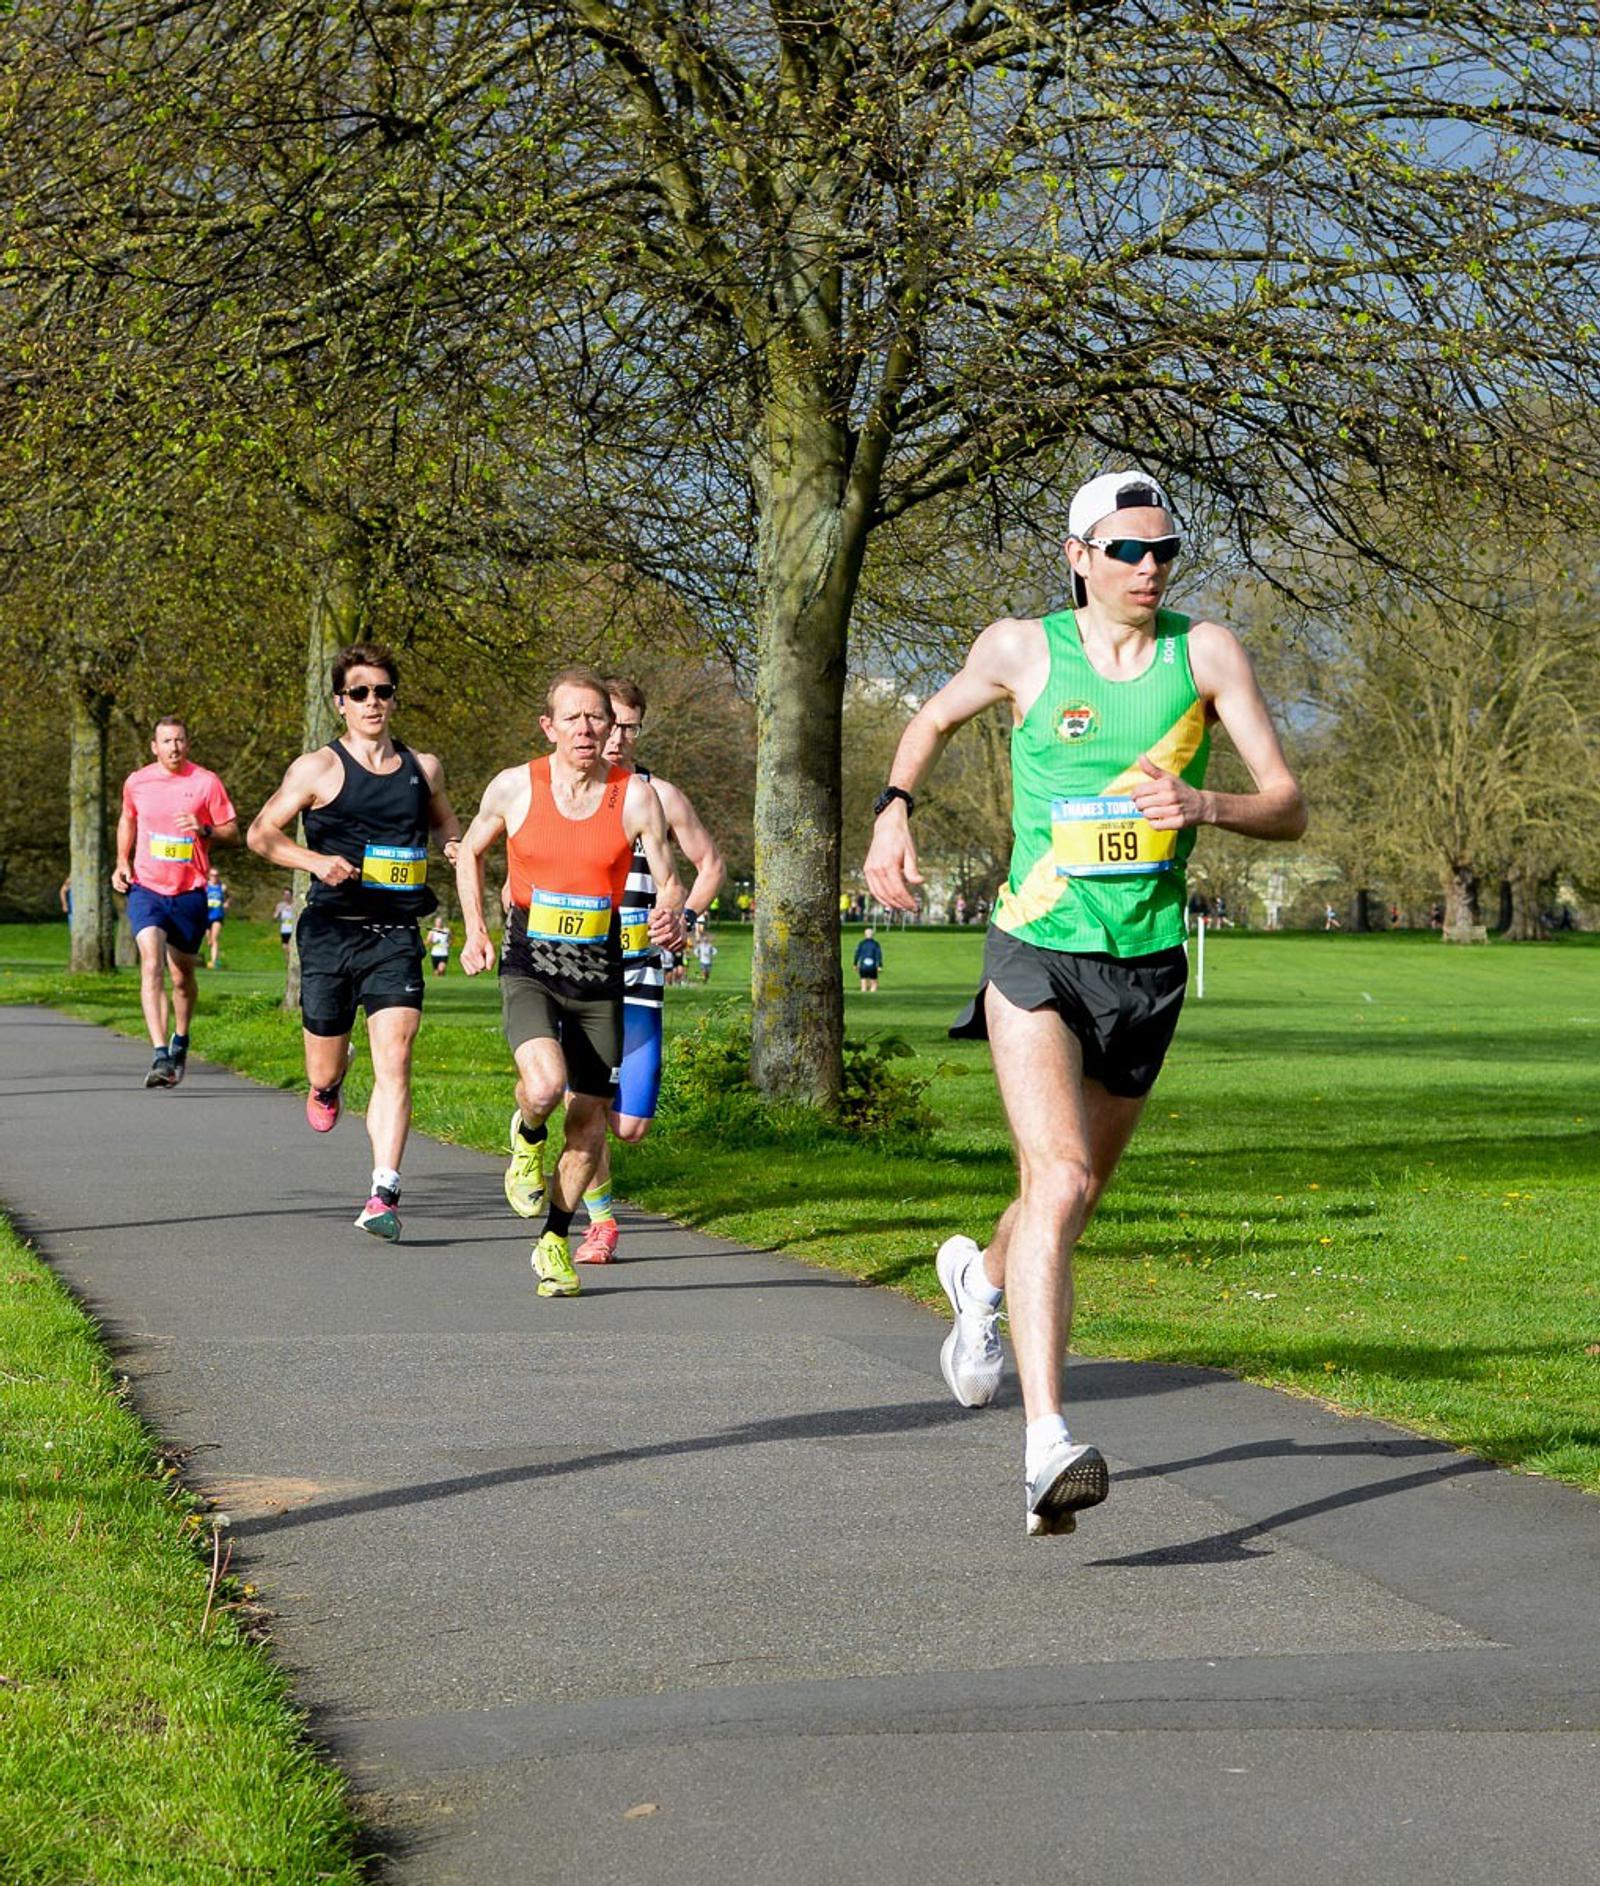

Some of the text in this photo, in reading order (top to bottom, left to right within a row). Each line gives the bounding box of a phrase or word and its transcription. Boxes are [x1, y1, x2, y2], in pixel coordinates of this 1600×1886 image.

[1062, 800, 1139, 817] THAMES TOWP
[1098, 831, 1138, 862] 159
[390, 866, 409, 883] 89
[539, 892, 566, 907] THAMES
[557, 915, 584, 935] 167
